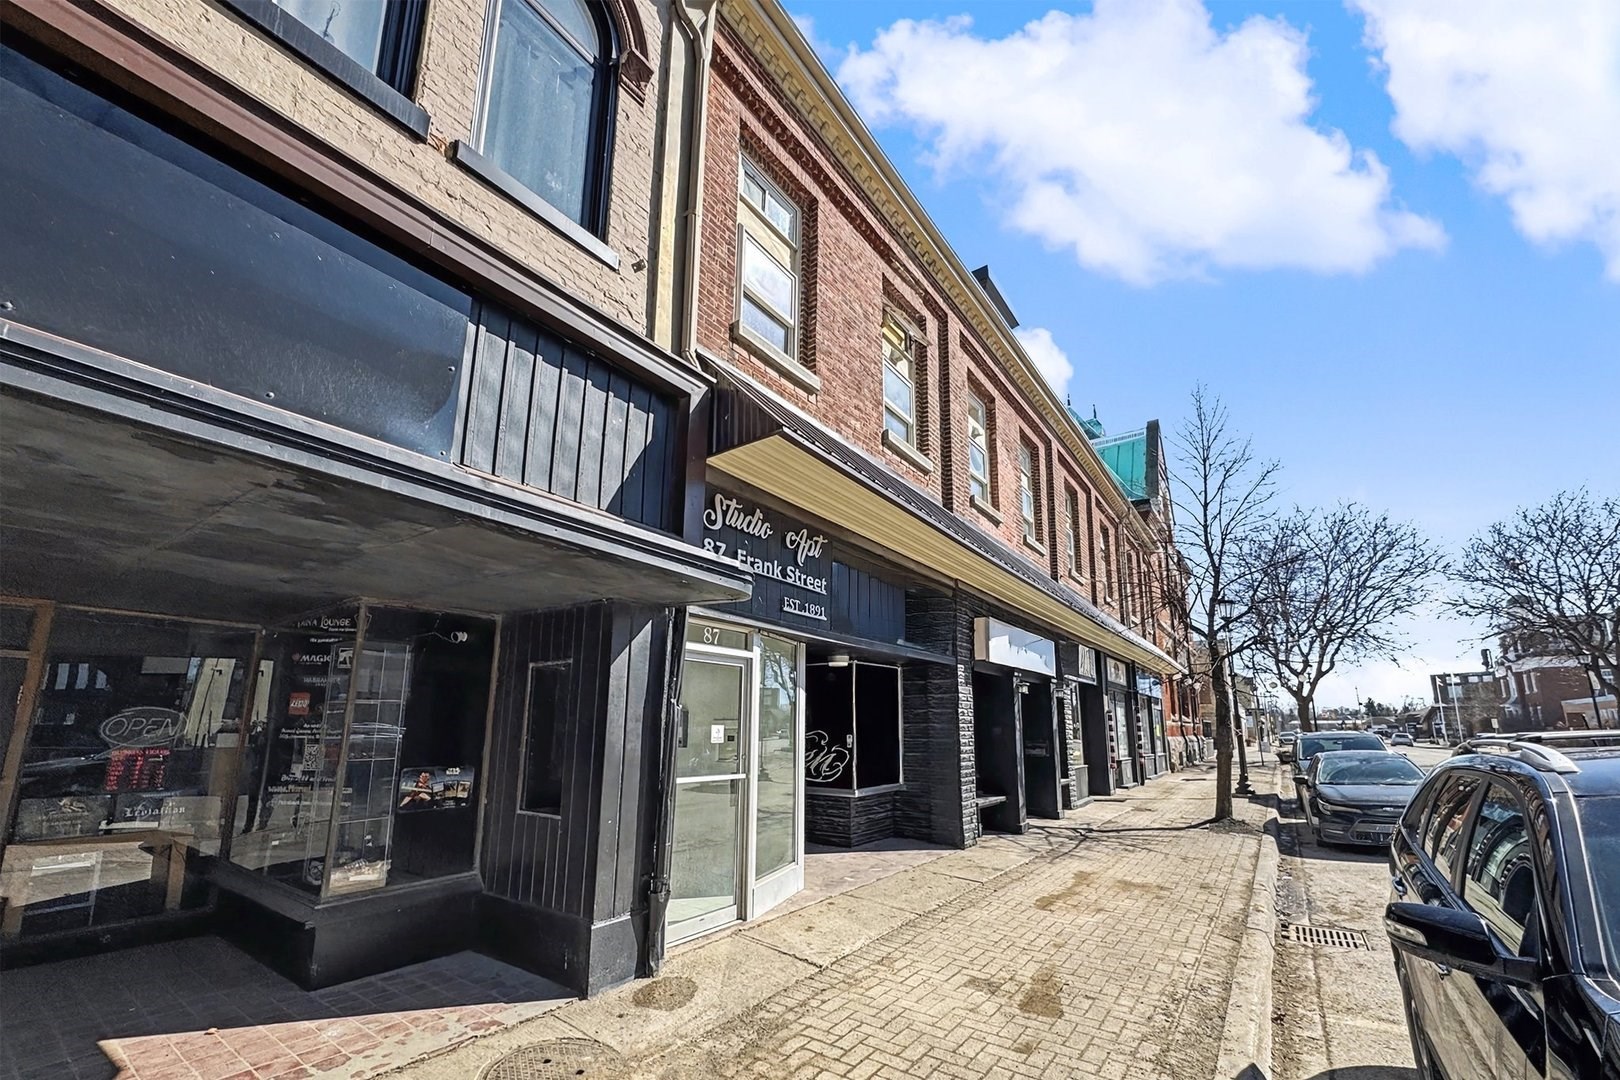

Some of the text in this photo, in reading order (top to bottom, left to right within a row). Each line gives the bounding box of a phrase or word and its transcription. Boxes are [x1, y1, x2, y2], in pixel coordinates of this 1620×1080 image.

[703, 493, 828, 567] Studio Apt
[703, 538, 828, 594] 87 Frank Street
[320, 615, 352, 629] LOUNGE
[703, 626, 720, 645] 87
[106, 717, 180, 737] OPEN
